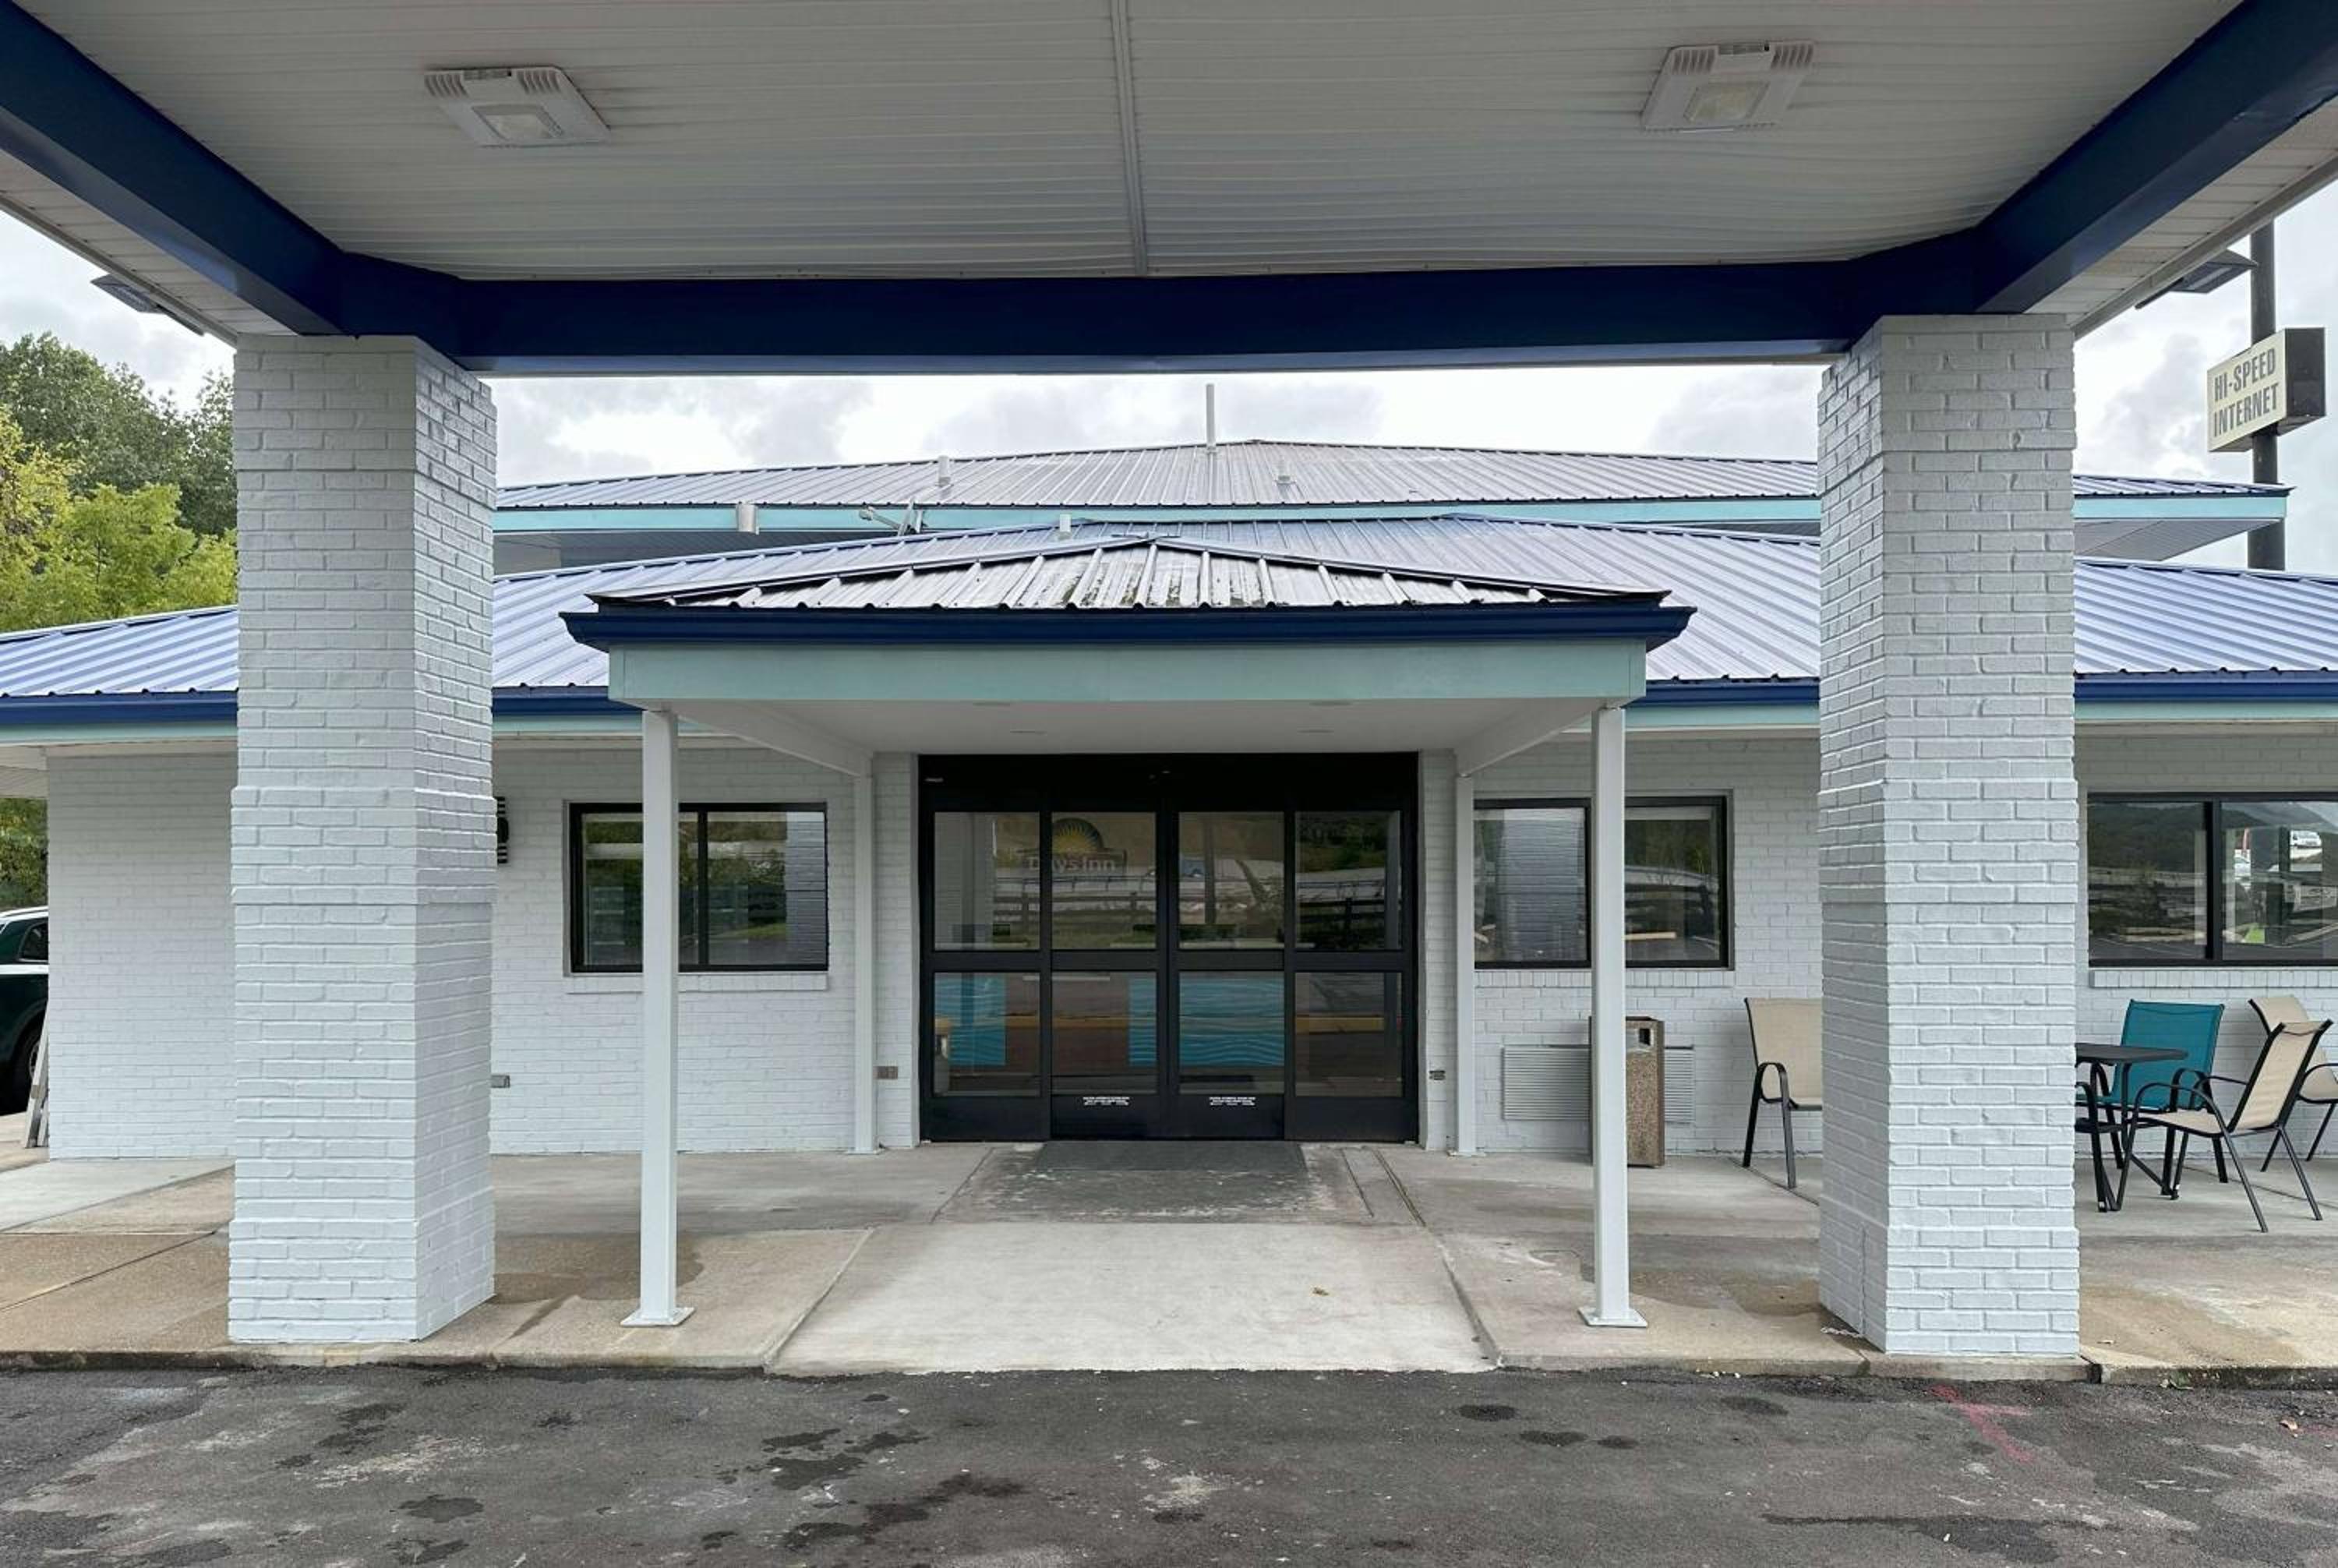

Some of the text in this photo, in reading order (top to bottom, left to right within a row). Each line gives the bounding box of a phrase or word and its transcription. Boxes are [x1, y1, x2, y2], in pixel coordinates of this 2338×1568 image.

[2214, 348, 2276, 401] HI-SPEED
[2214, 383, 2278, 437] INTERNET
[1029, 856, 1082, 873] Dys
